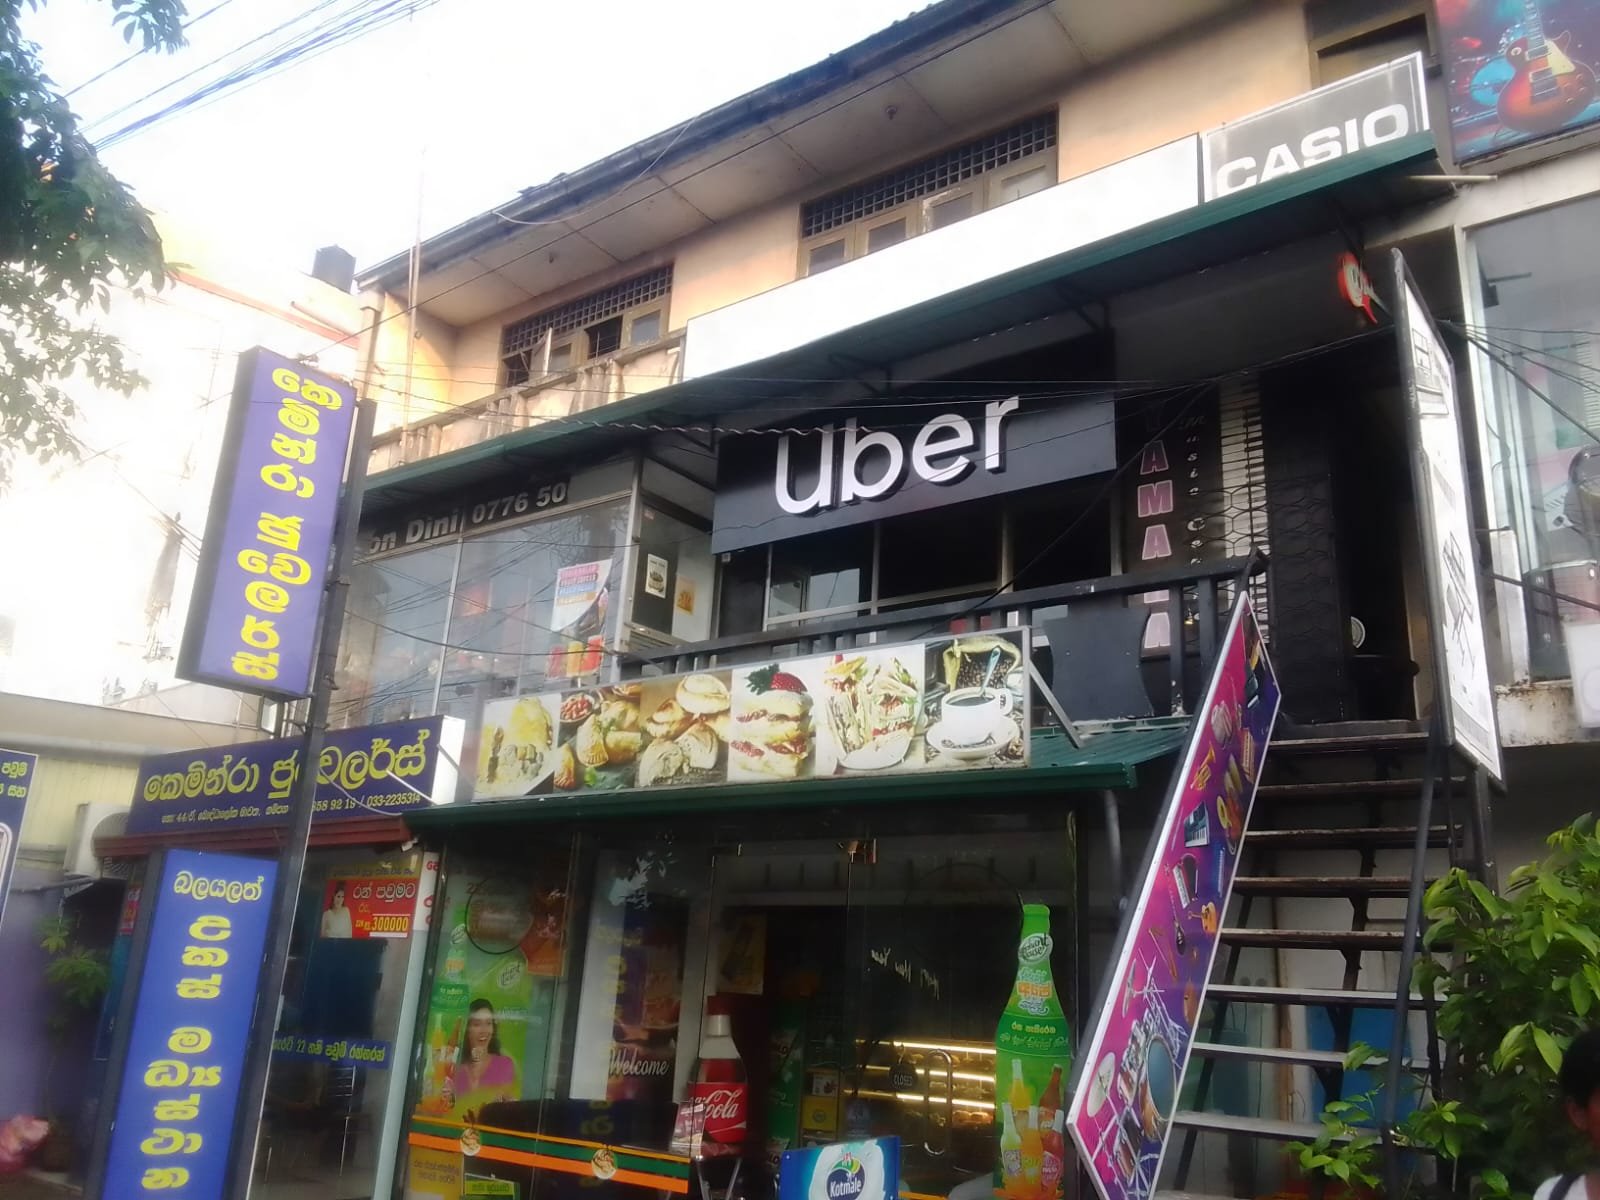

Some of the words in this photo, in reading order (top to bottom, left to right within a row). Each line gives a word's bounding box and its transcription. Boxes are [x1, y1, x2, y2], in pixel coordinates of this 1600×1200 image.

[1216, 102, 1409, 196] CASIO
[471, 491, 528, 525] 0776
[535, 481, 567, 508] 50
[371, 916, 409, 932] 300000
[608, 1046, 670, 1078] Welcome
[829, 1174, 863, 1199] Kotmale
